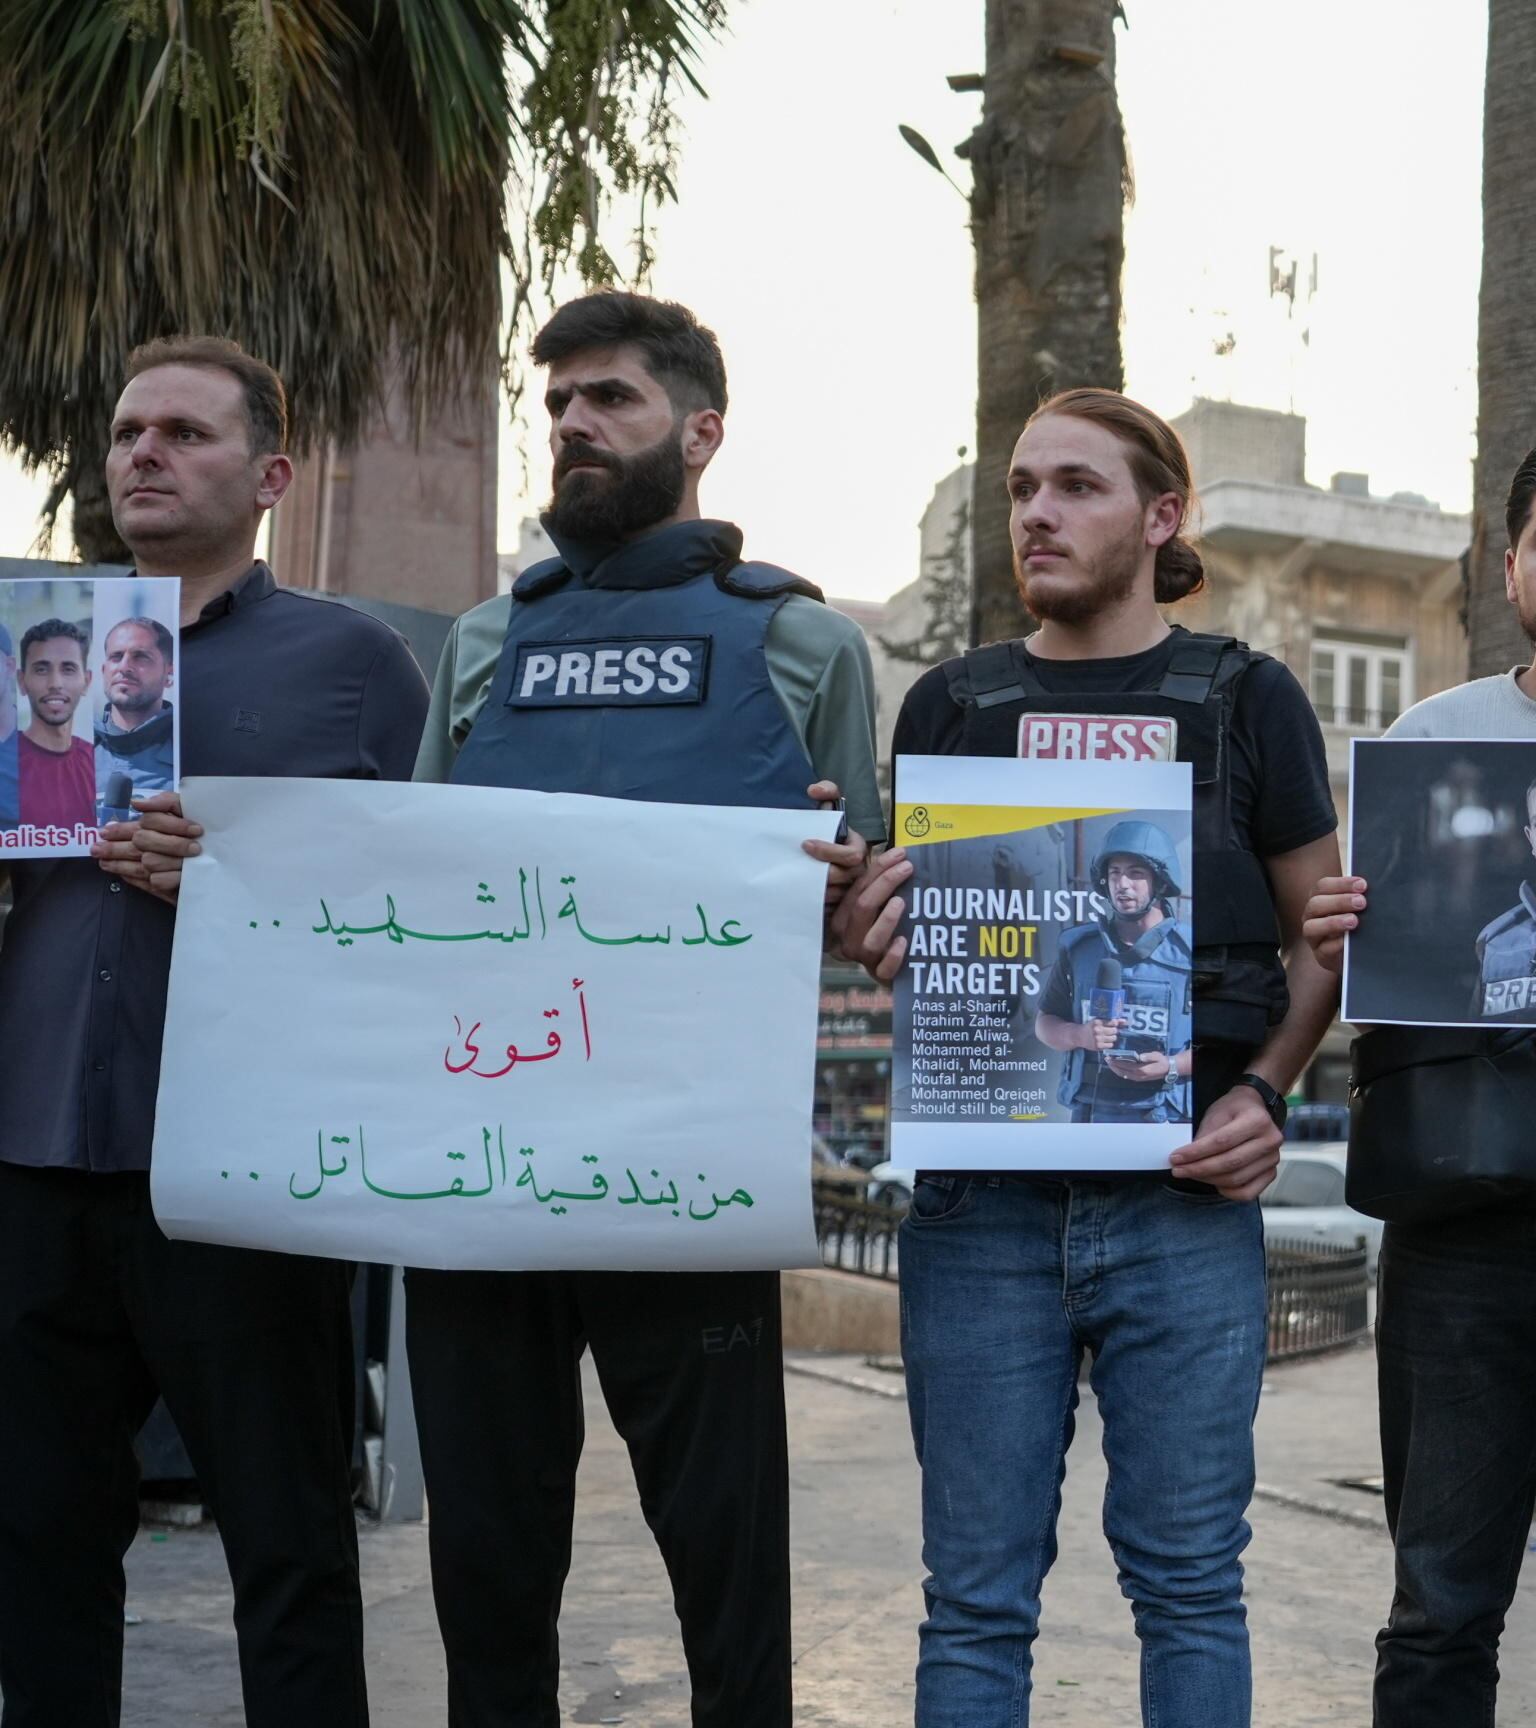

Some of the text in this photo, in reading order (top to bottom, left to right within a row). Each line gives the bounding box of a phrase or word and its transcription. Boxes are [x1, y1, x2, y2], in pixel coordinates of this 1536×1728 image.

[519, 646, 692, 698] PRESS
[1027, 721, 1167, 762] PRESS
[0, 825, 98, 848] alists in
[312, 866, 546, 948] الشهيد
[559, 874, 754, 948] عدسة
[908, 887, 1106, 922] JOURNALISTS
[909, 924, 1037, 958] ARE NOT
[908, 962, 1041, 995] TARGETS
[911, 999, 1011, 1014] Anas al-Sharif,
[912, 1014, 1011, 1029] Ibrahim Zaher,
[912, 1028, 1014, 1043] Moamen Aliwa,
[912, 1043, 1012, 1056] Mohammed al-
[911, 1058, 1047, 1072] Khalidi, Mohammed
[911, 1072, 985, 1085] Noufal and
[910, 1102, 1046, 1116] should still be alive.
[911, 1087, 1046, 1102] Mohammed Qreiqeh
[289, 1123, 506, 1202] القاتل
[515, 1146, 682, 1217] بندقية
[687, 1169, 755, 1222] من
